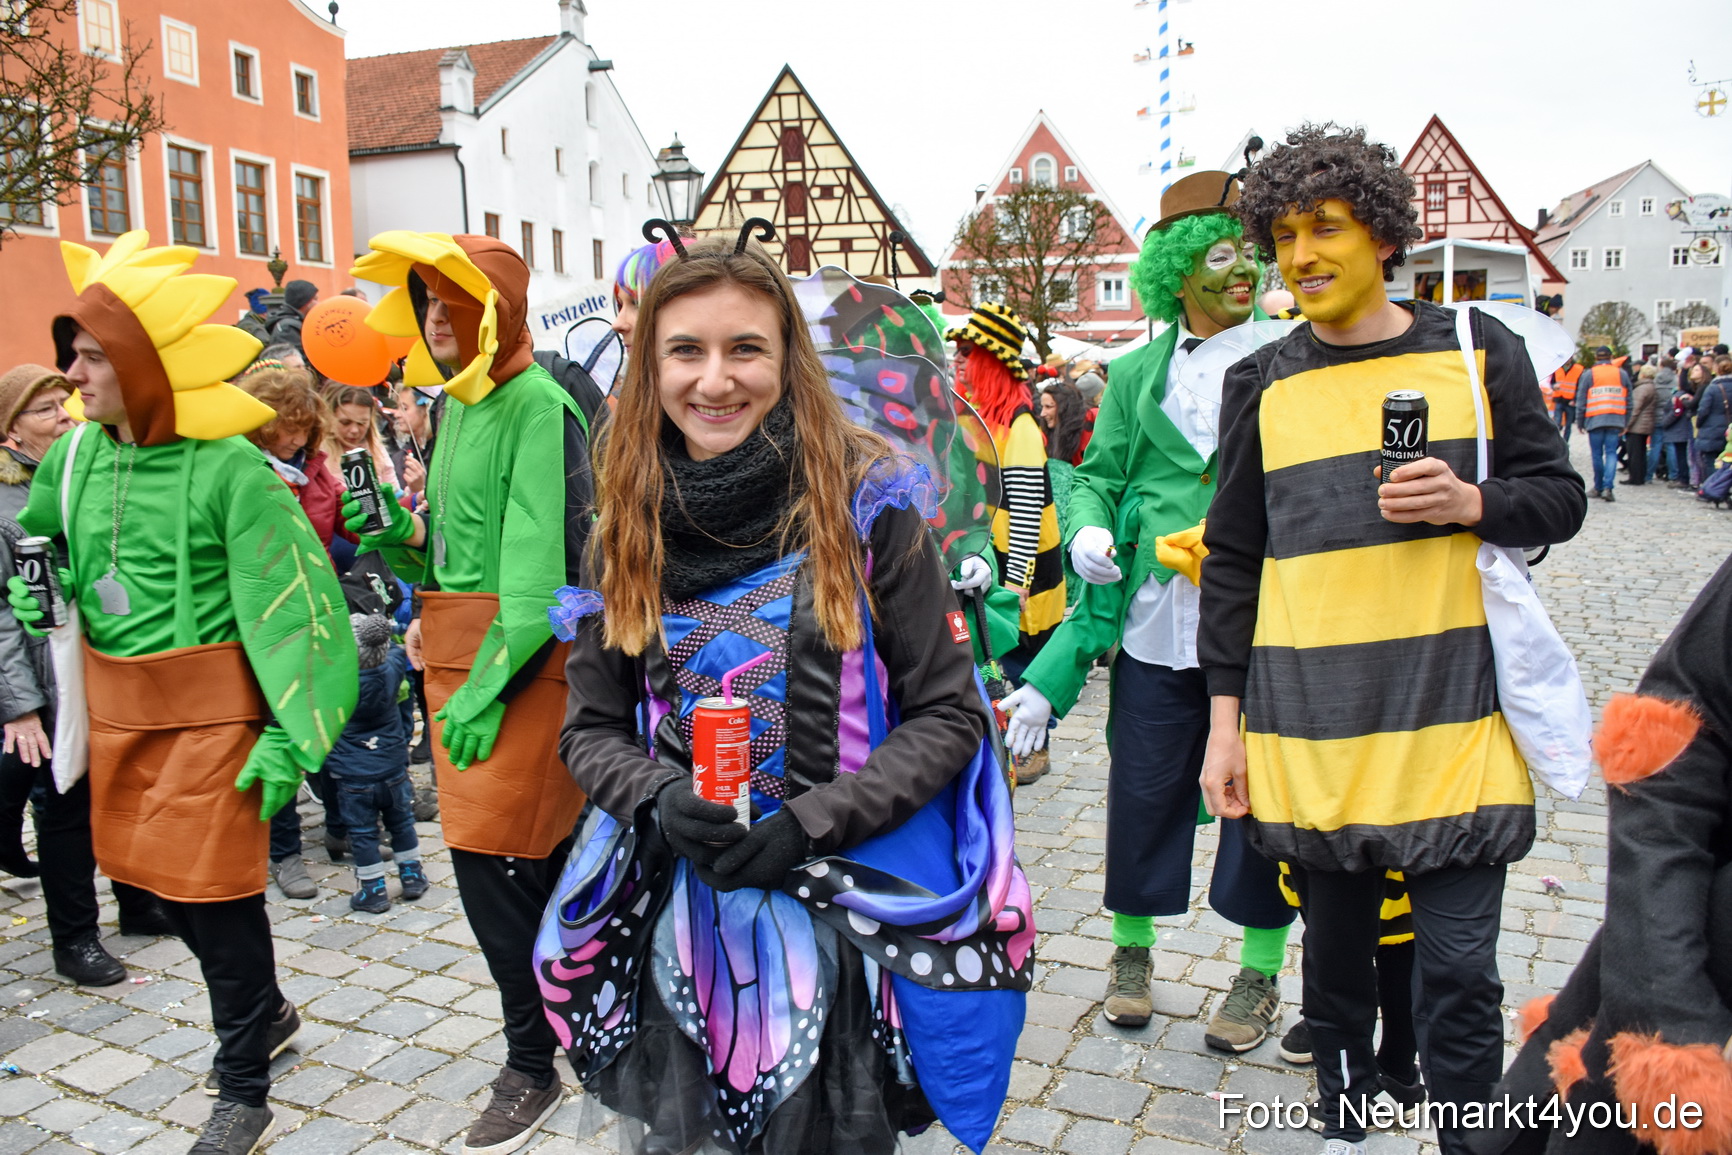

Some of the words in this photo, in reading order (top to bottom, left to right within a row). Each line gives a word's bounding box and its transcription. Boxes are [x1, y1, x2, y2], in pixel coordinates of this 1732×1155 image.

[541, 294, 608, 330] Festzelte
[1383, 417, 1423, 449] 5,0
[1381, 448, 1424, 459] ORIGINAL
